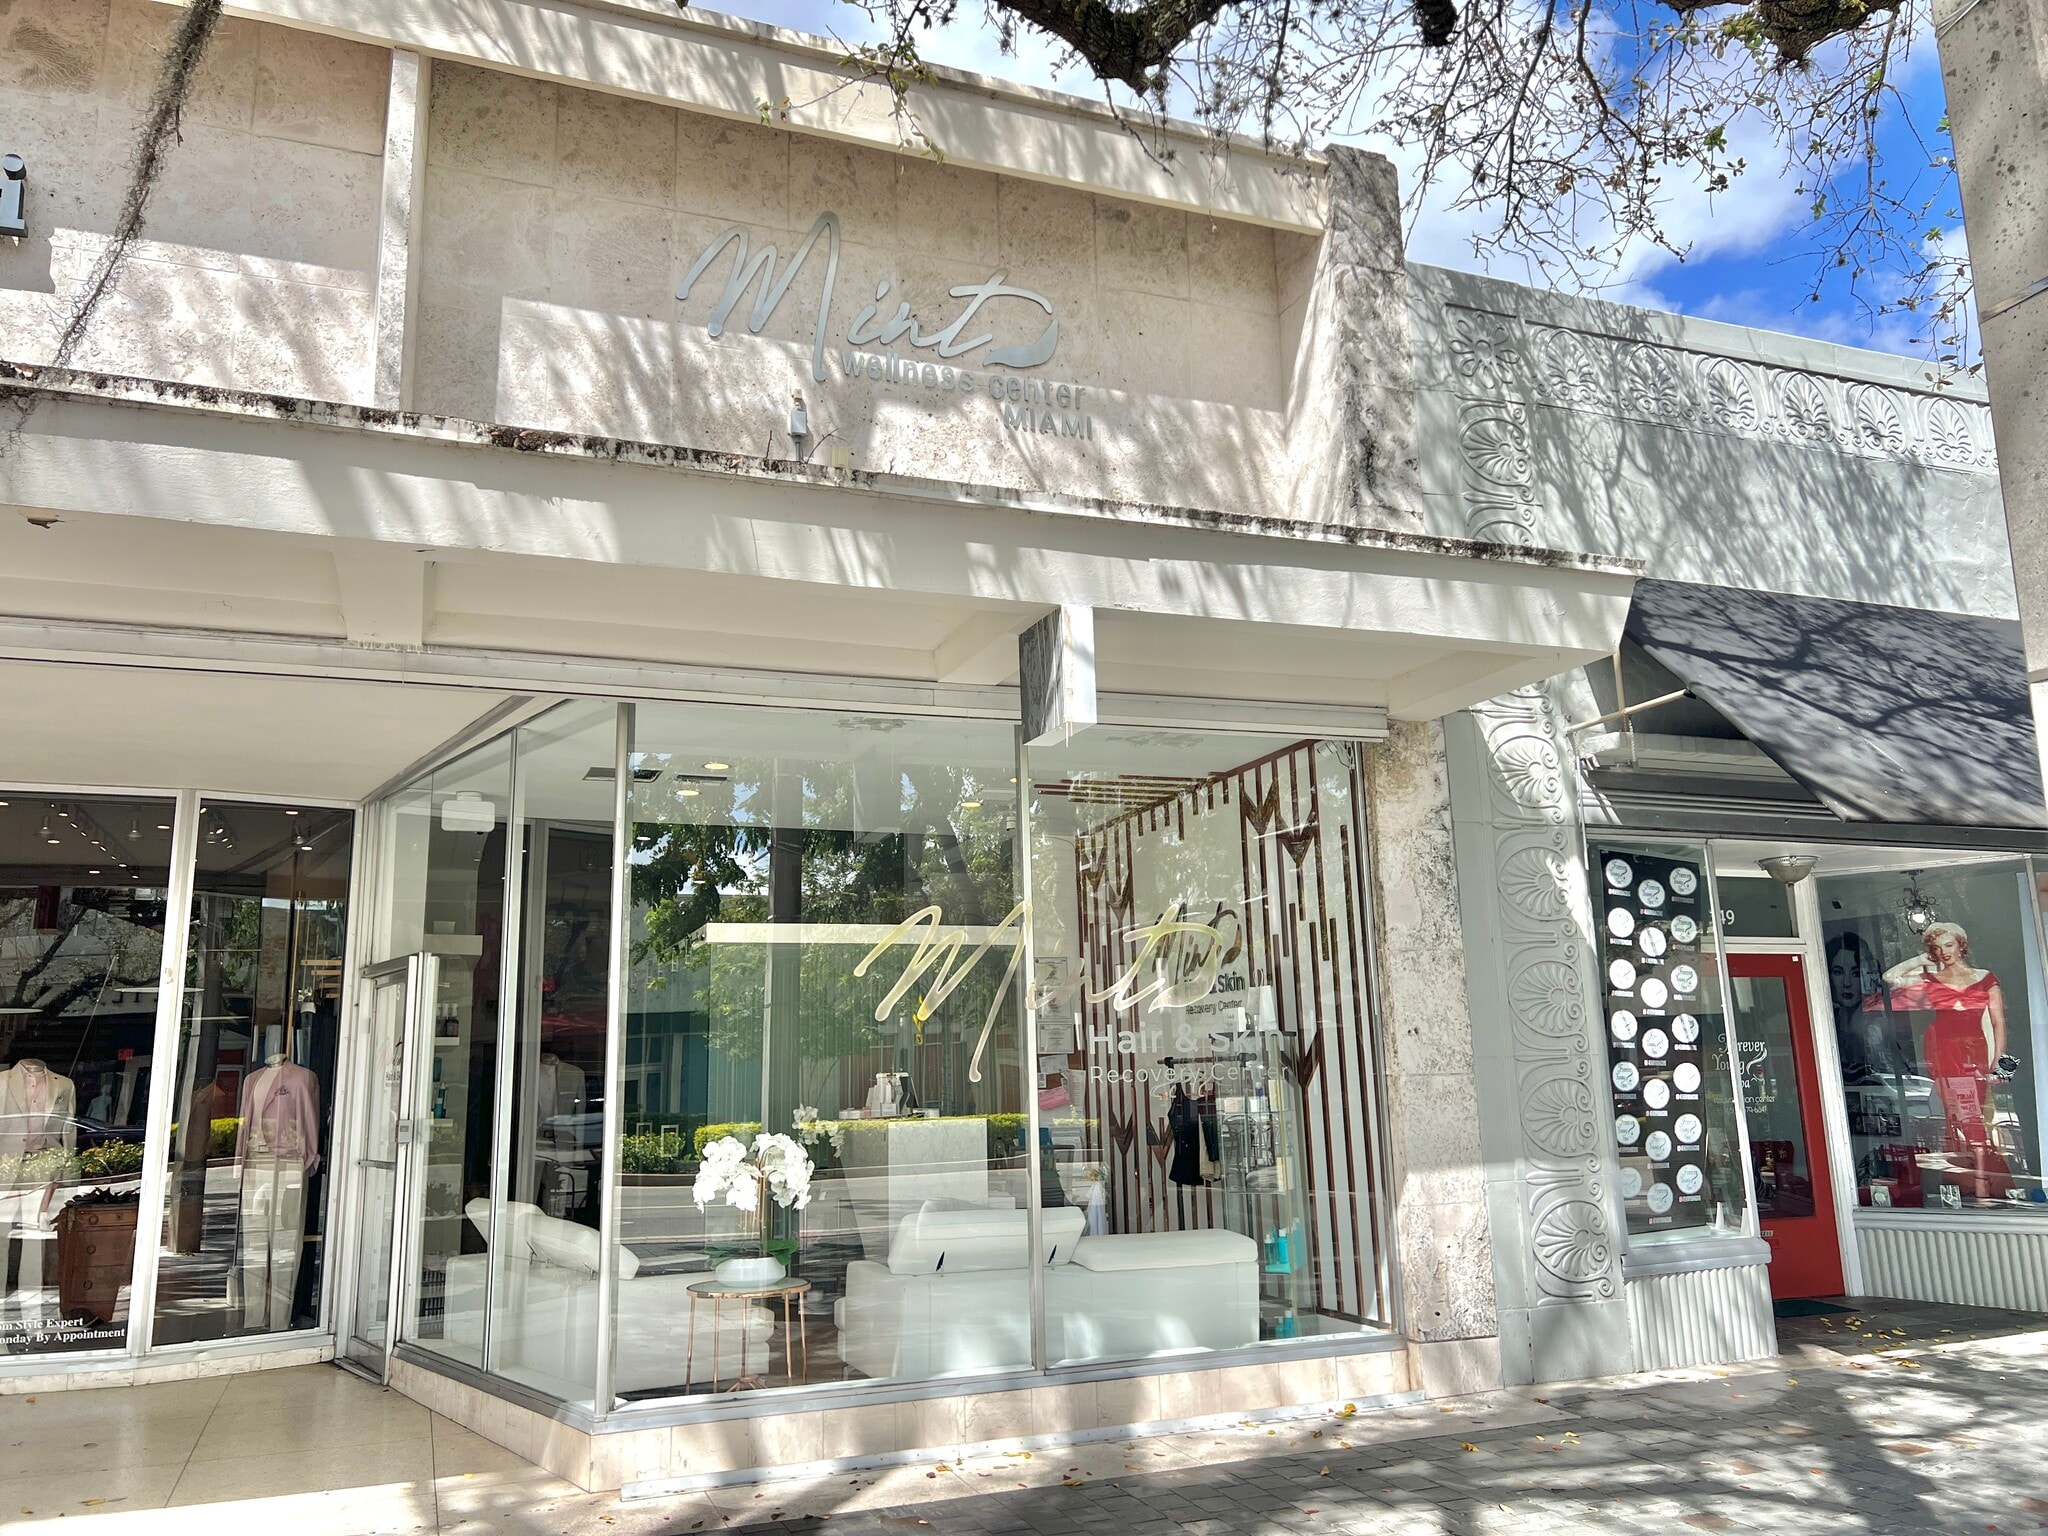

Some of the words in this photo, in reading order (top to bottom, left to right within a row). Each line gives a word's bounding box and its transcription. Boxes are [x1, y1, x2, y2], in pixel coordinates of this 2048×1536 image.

[675, 210, 1059, 382] Mint
[840, 347, 974, 393] wellness
[988, 373, 1086, 410] center
[1003, 403, 1093, 441] MIAMI
[1217, 970, 1246, 993] Skin
[1088, 1021, 1163, 1055] Hair
[1174, 1023, 1199, 1054] &
[1090, 1066, 1203, 1089] Recovery
[1211, 1063, 1288, 1081] Center
[15, 1319, 44, 1332] Style
[46, 1317, 85, 1328] Expert
[36, 1332, 51, 1344] By
[54, 1328, 126, 1343] Appointment
